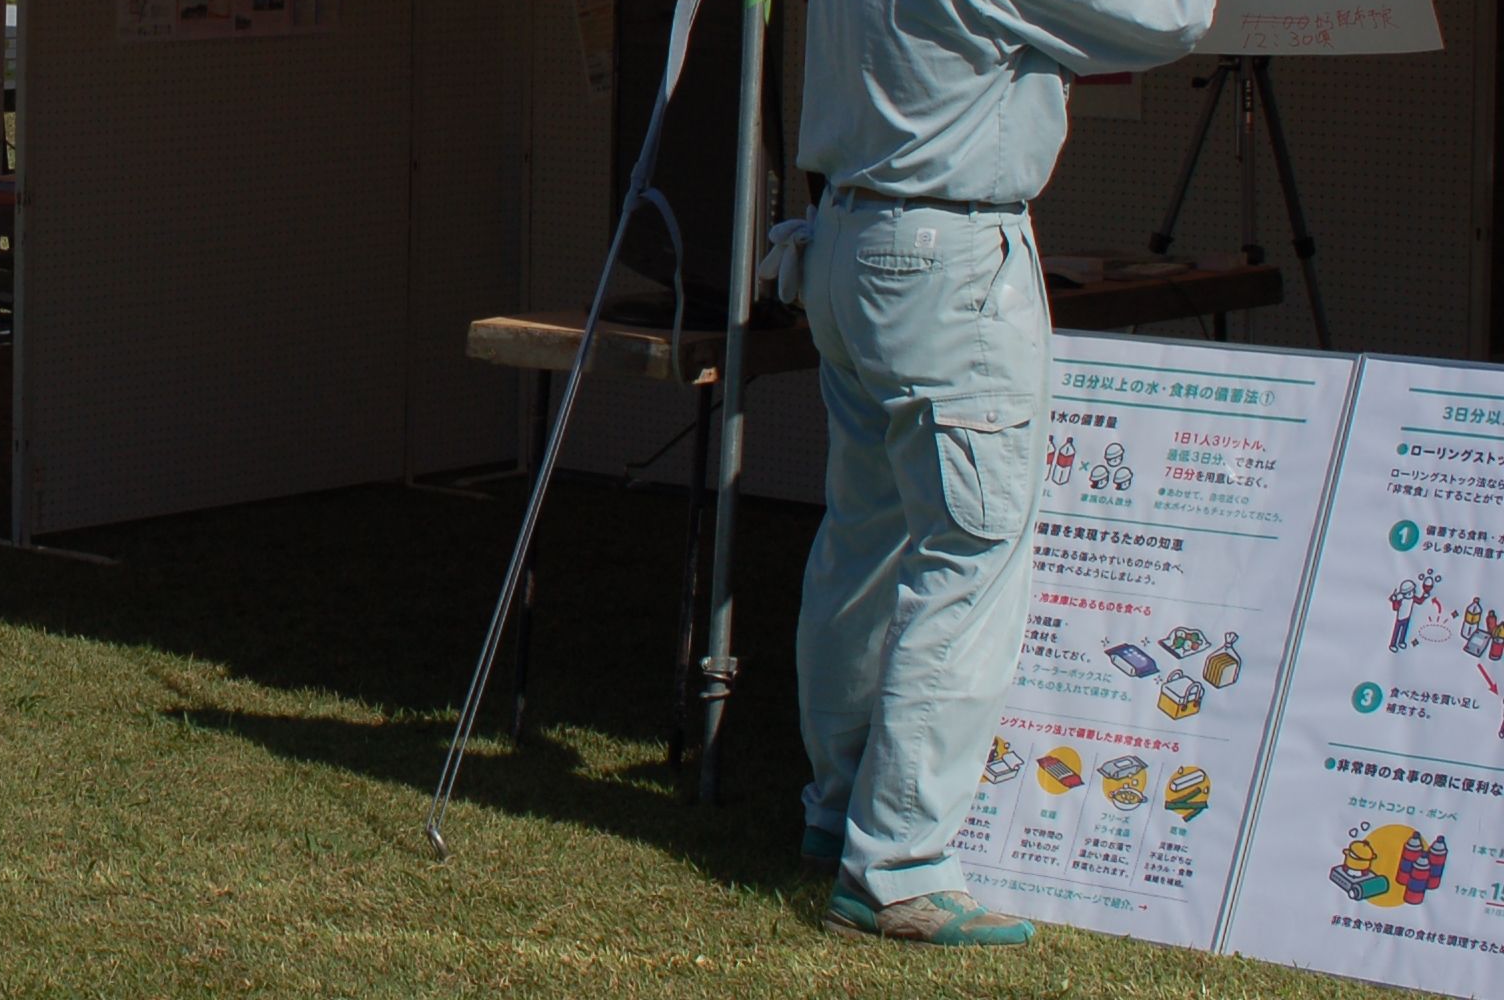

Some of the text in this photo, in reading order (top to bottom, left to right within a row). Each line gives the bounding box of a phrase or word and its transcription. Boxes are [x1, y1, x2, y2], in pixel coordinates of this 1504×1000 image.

[1051, 410, 1118, 429] 水の備蓄量
[1443, 406, 1504, 426] 3日分以
[1034, 521, 1184, 551] 備蓄を実現するための知恵
[1021, 643, 1090, 663] い置きしておく。
